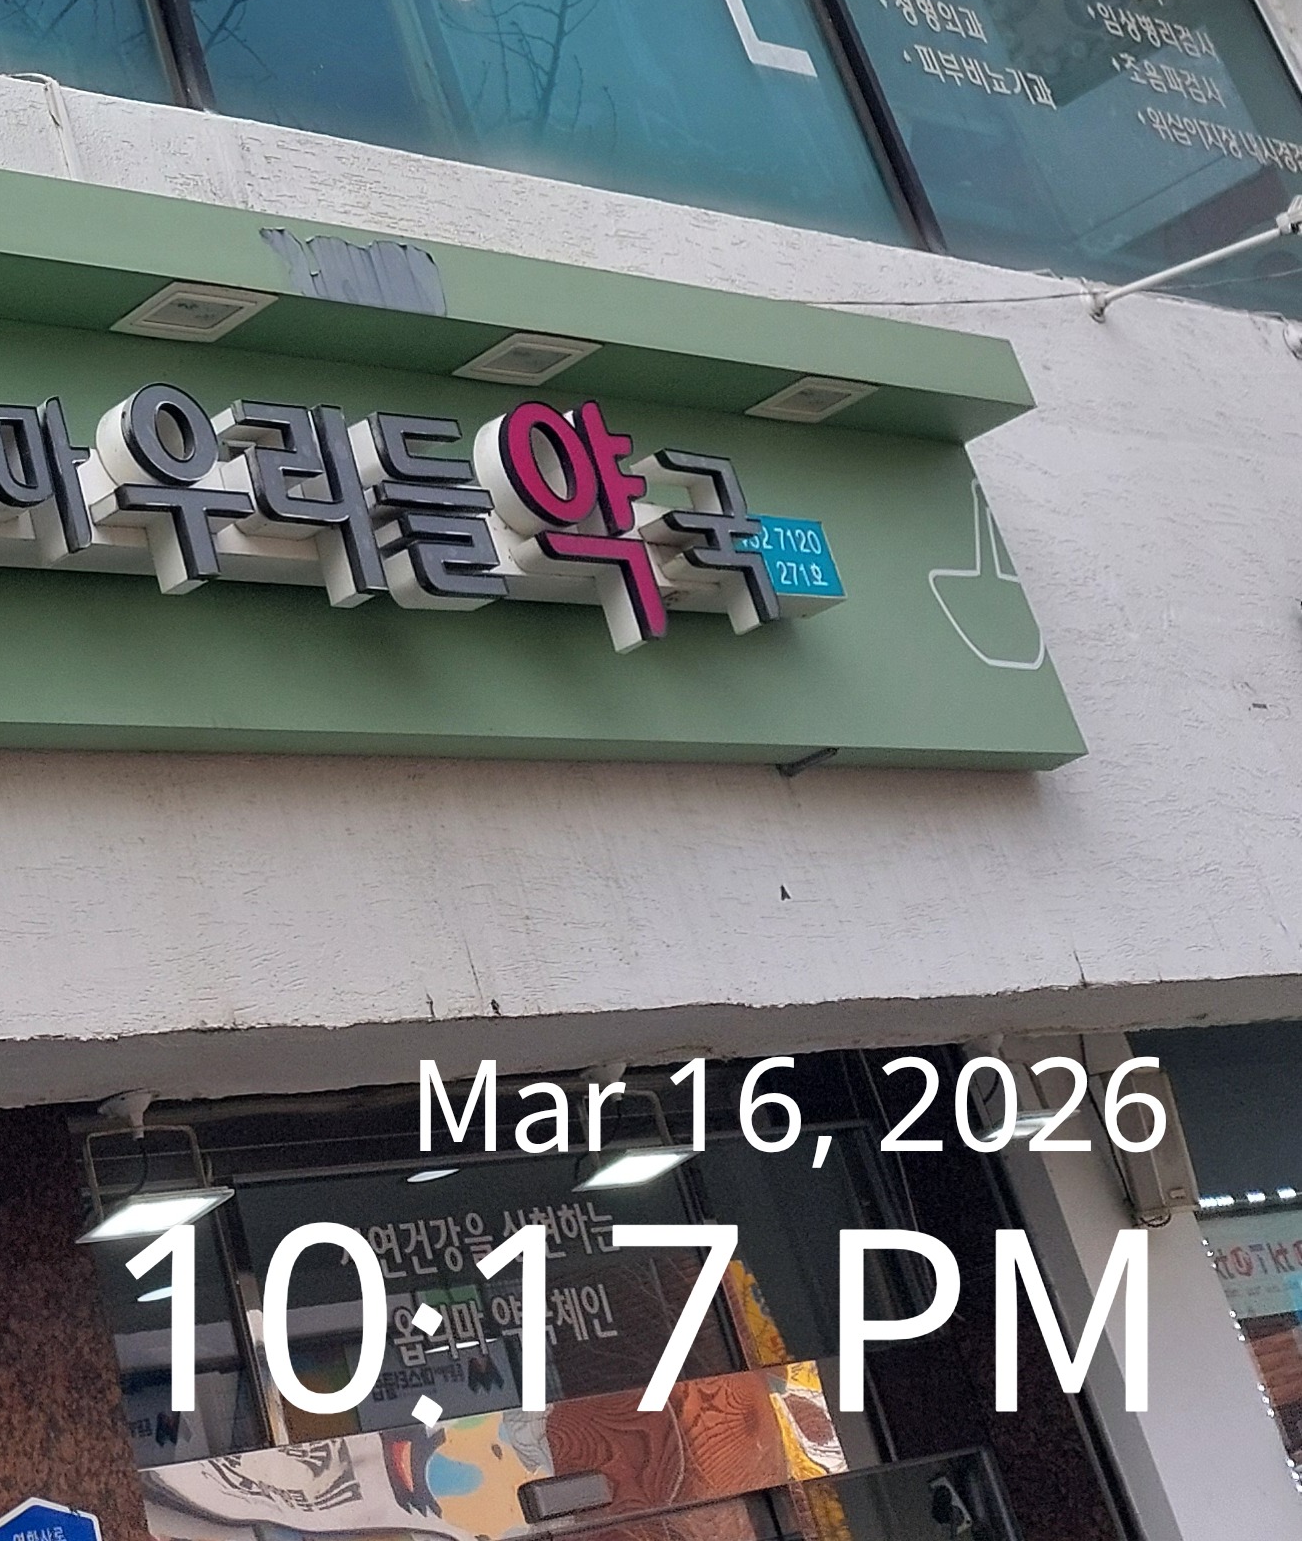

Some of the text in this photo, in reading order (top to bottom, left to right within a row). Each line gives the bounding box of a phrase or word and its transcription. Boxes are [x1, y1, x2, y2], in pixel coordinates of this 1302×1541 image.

[1096, 1, 1220, 65] 임상병리검사
[913, 43, 1058, 111] 피부비뇨기과
[1120, 52, 1227, 110] 초음파검사
